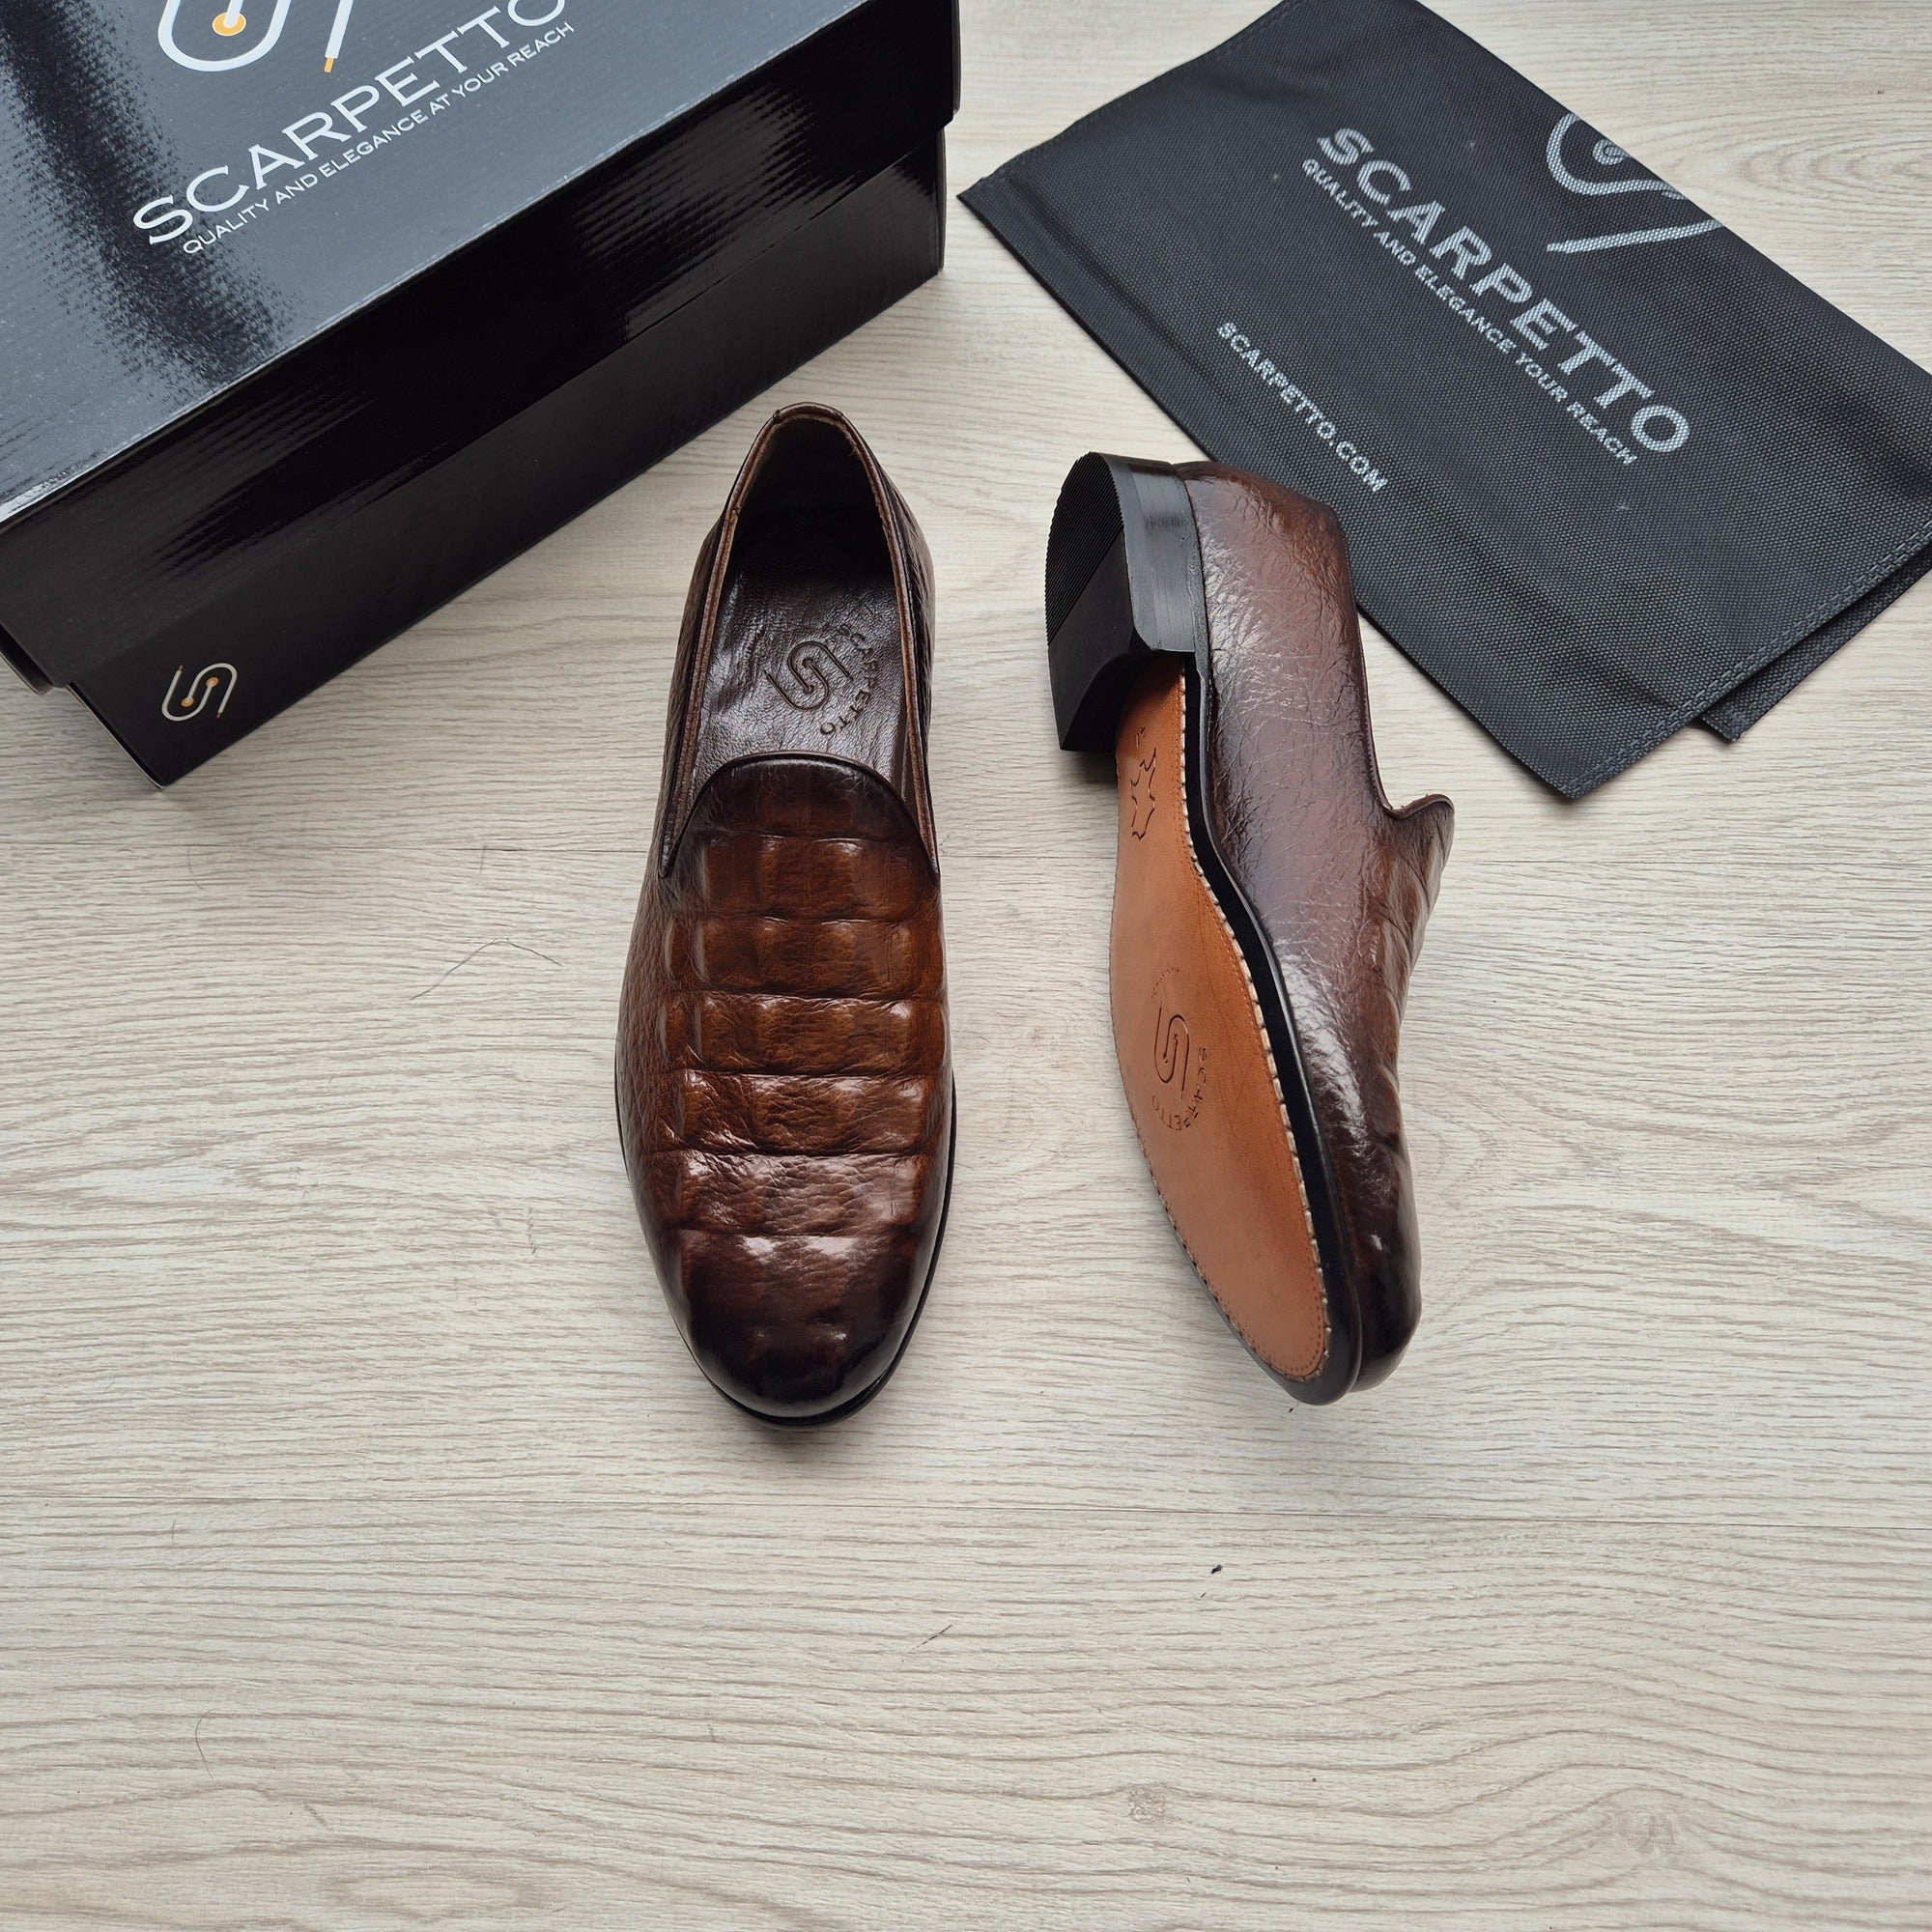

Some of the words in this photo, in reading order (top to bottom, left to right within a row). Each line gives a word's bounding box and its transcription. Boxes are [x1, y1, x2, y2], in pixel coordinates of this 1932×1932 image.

[133, 0, 565, 244] SCARPETTO
[183, 198, 270, 254] QUALITY
[274, 173, 318, 205] AND
[318, 109, 429, 178] ELEGANCE
[429, 93, 451, 115] AT
[451, 62, 509, 98] YOUR
[506, 21, 575, 67] REACH
[1217, 322, 1388, 492] SCARPETTO.COM
[1302, 157, 1378, 227] QUALITY
[1373, 231, 1416, 266] AND
[1415, 264, 1517, 354] ELEGANCE
[1515, 352, 1568, 403] YOUR
[1566, 401, 1637, 465] REACH
[1317, 128, 1690, 452] SCARPETTO
